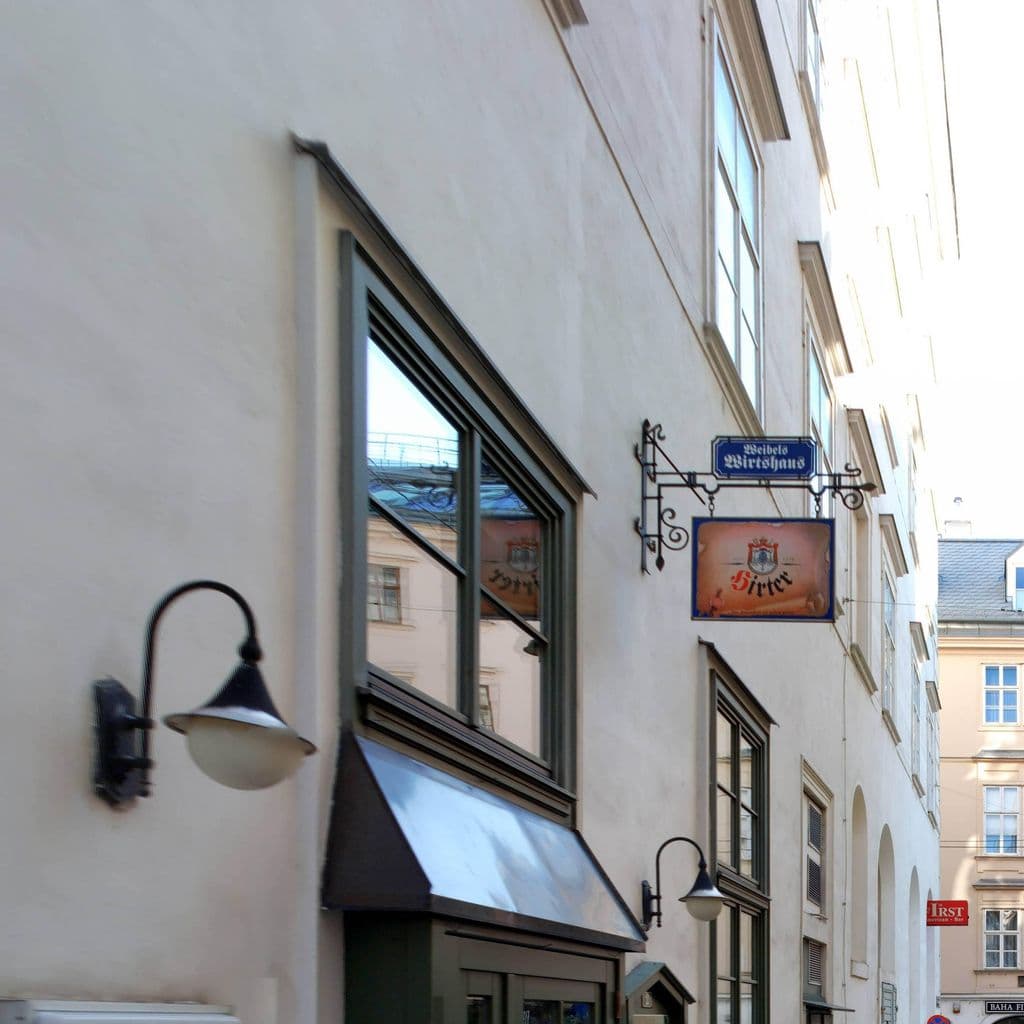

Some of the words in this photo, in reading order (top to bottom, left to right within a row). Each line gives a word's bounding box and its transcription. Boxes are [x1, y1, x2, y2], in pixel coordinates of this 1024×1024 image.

[743, 444, 788, 455] Weibels
[723, 454, 806, 472] Wirtshaus
[731, 570, 793, 597] Hirter
